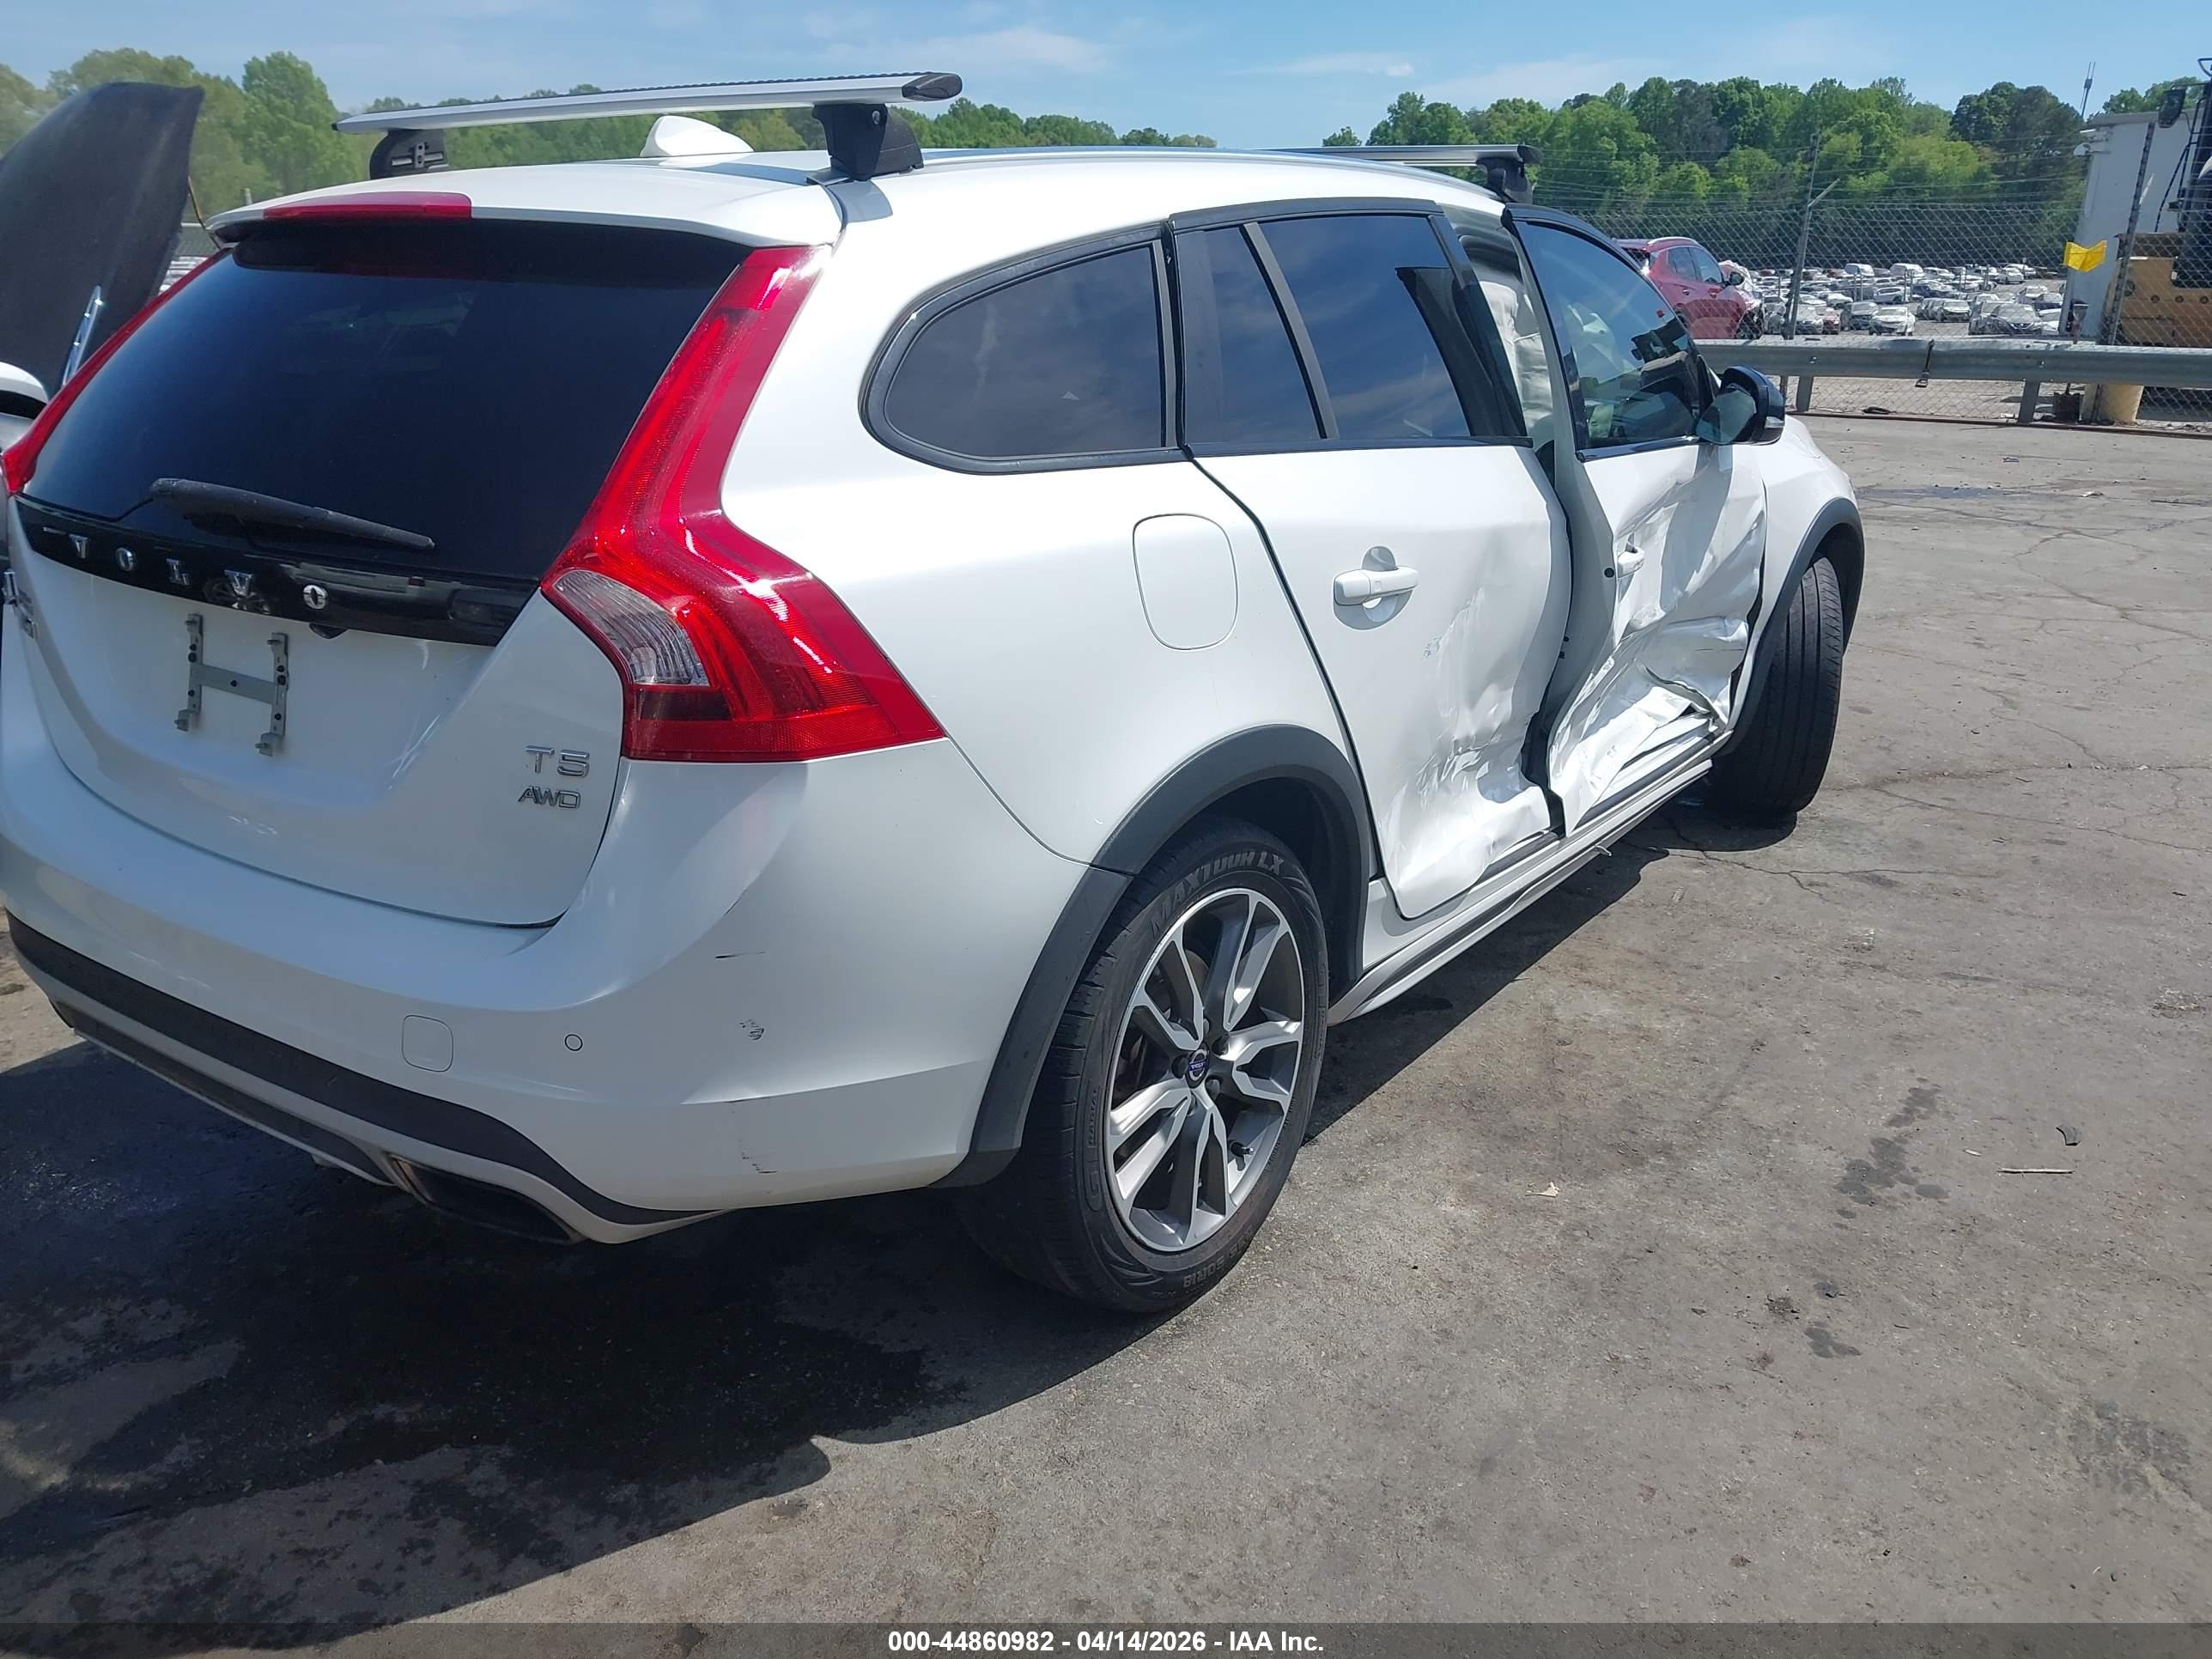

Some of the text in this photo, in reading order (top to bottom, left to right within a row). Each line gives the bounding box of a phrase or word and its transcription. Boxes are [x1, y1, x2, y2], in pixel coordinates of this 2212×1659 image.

[69, 533, 330, 611] VOLVO
[526, 744, 590, 778] T5
[517, 785, 581, 809] AWD
[1256, 851, 1285, 877] LX
